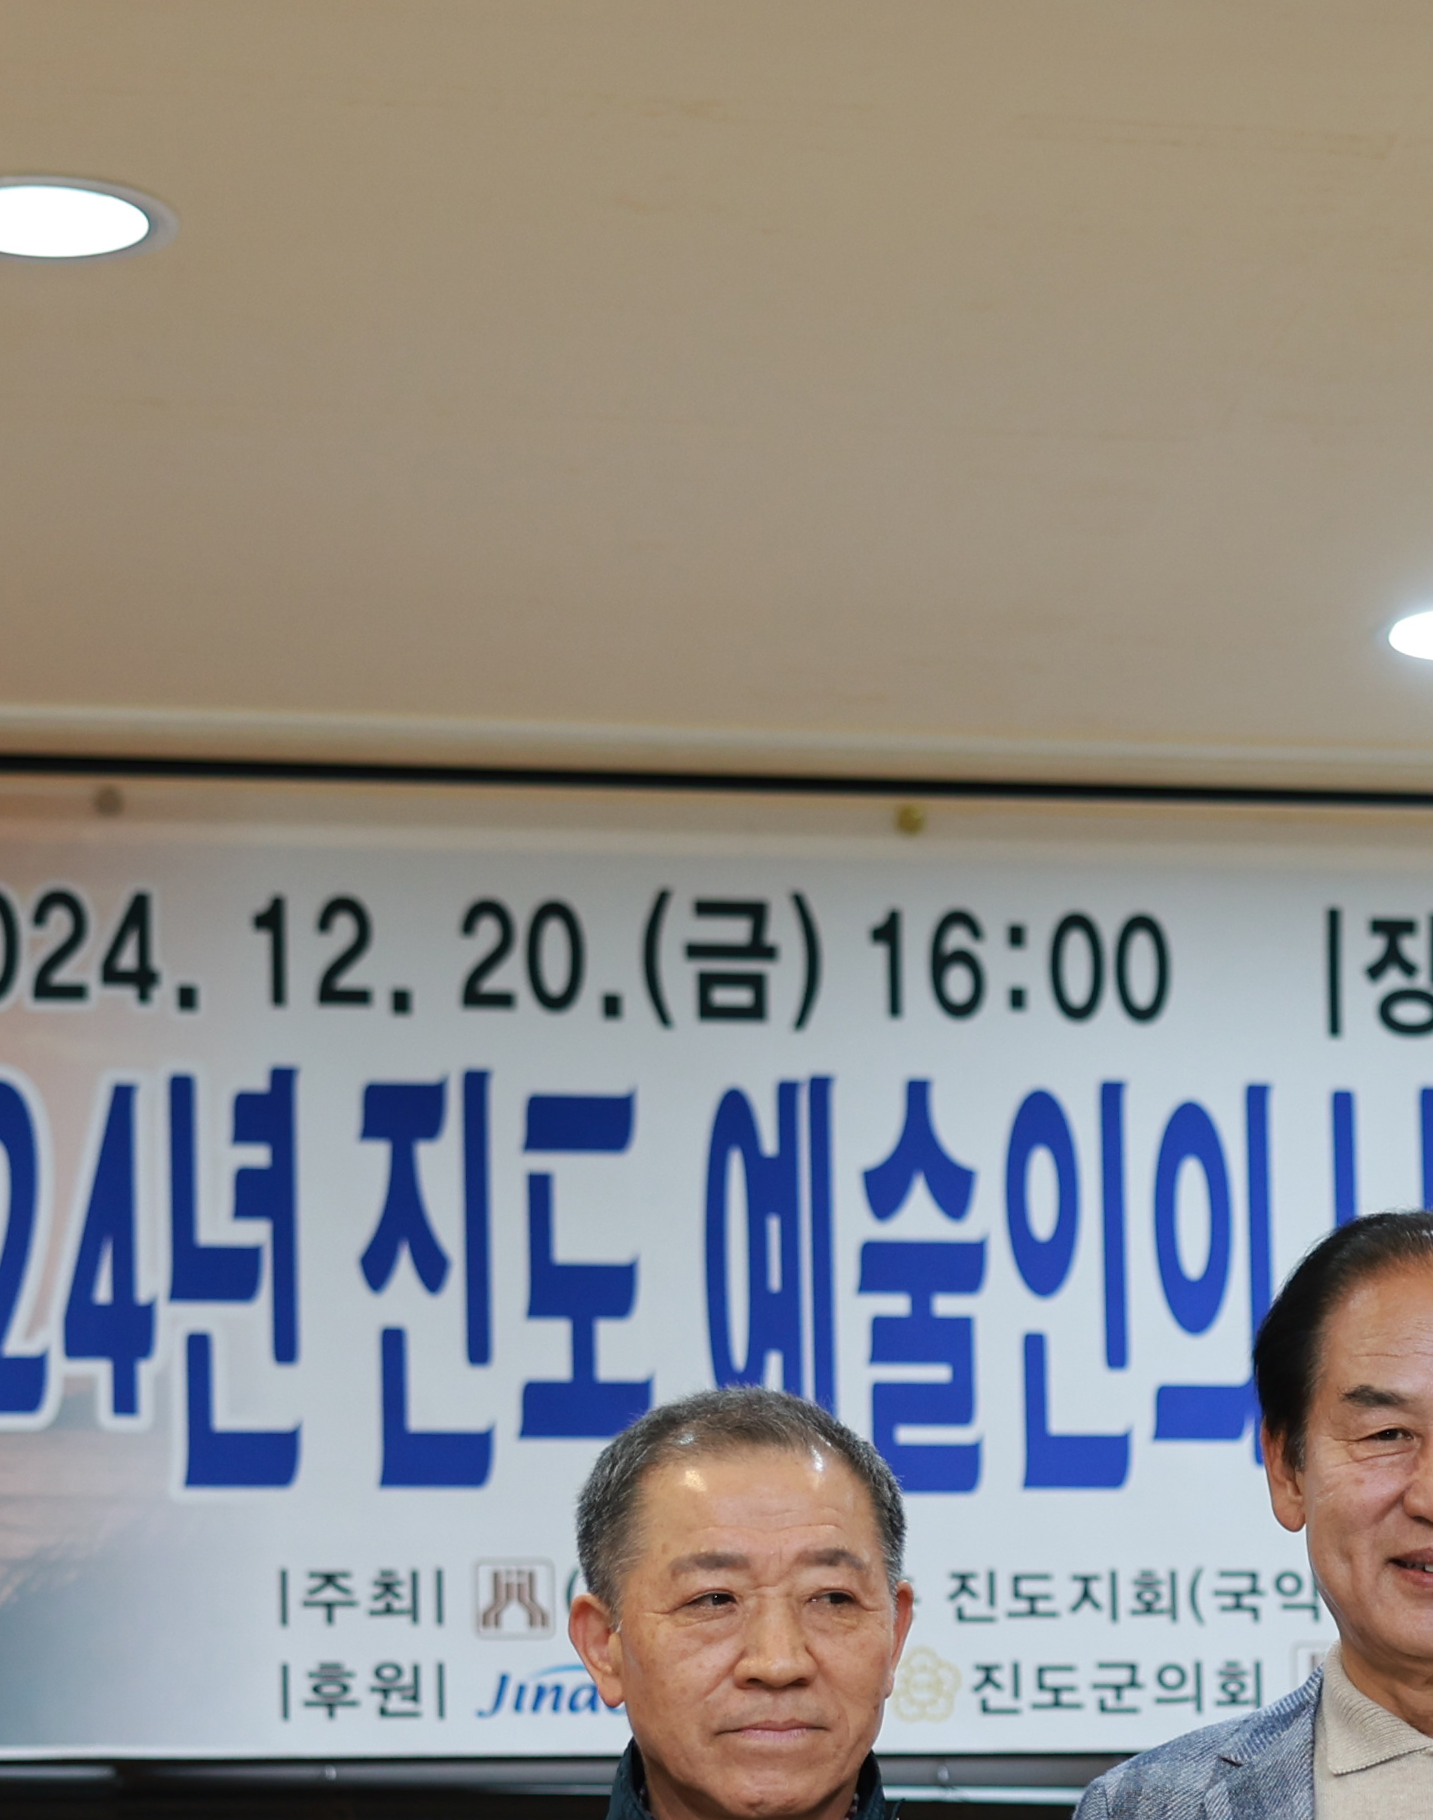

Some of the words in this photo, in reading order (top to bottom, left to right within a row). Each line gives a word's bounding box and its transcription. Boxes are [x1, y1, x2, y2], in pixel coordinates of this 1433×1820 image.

[254, 893, 415, 1014] 12.
[868, 908, 1172, 1024] 16:00
[357, 1068, 655, 1489] 진도
[706, 1074, 1273, 1494] 예술인의
[971, 1659, 1264, 1716] 진도군의회
